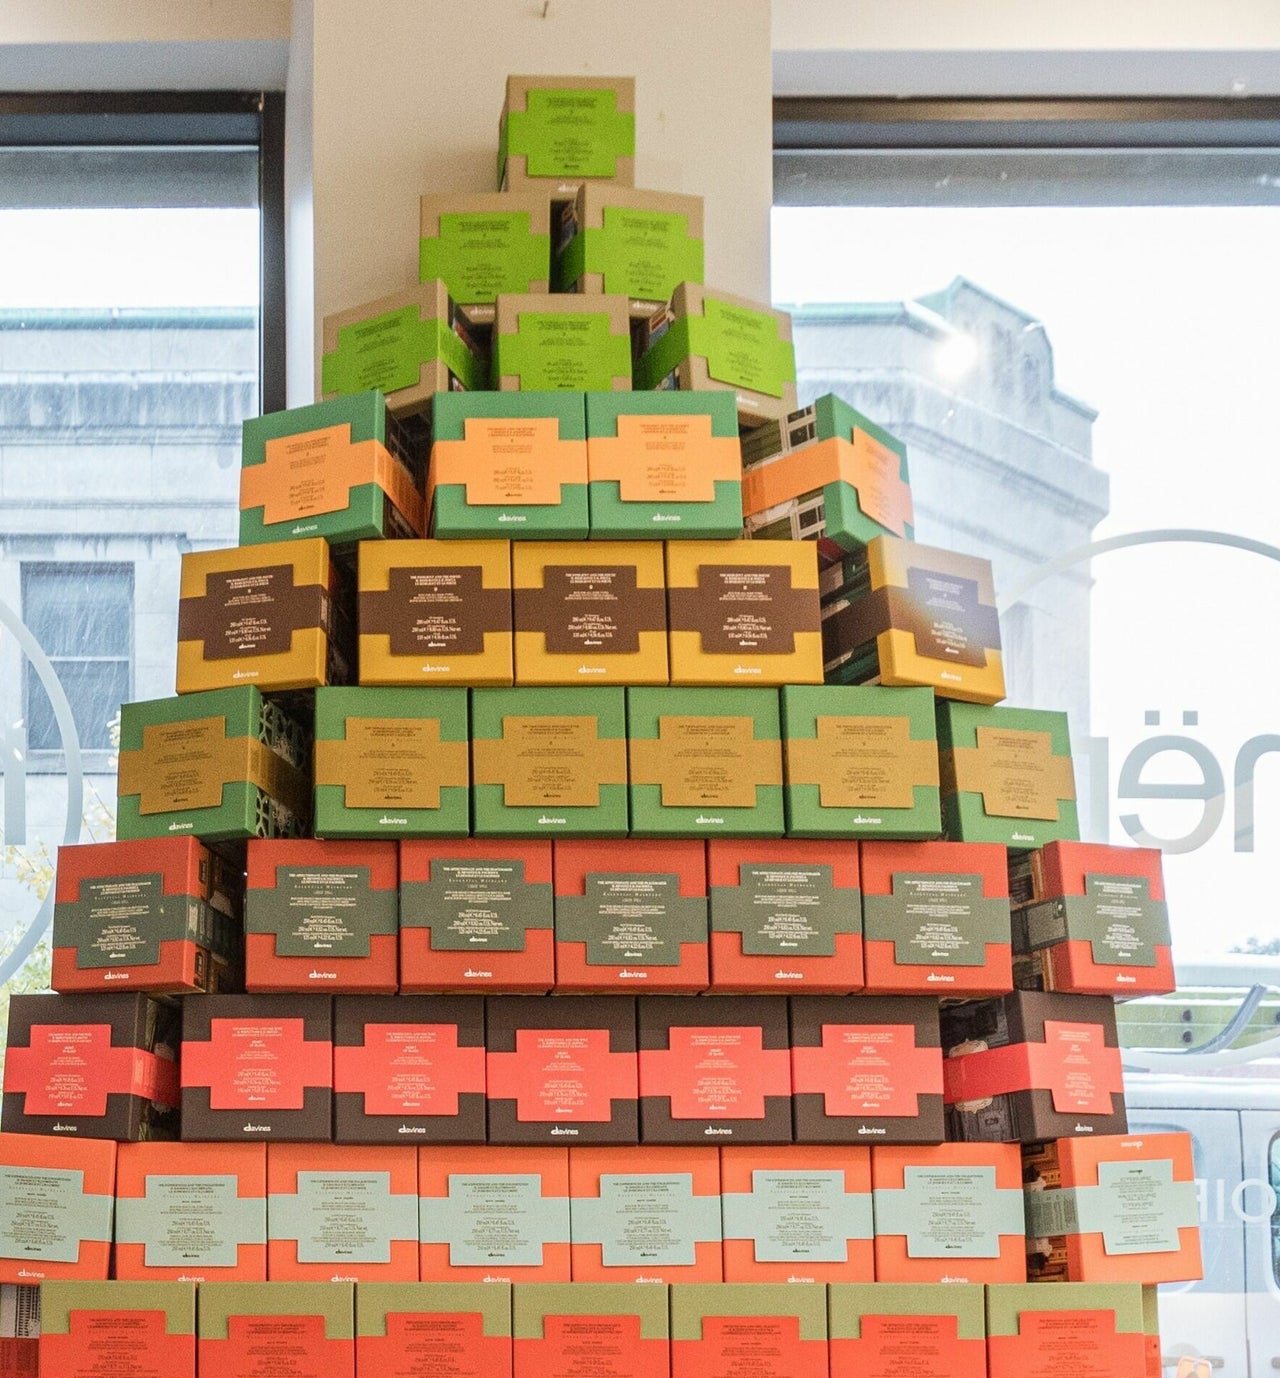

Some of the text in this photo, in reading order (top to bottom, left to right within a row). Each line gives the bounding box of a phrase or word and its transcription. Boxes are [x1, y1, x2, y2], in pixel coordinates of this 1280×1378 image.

[498, 514, 526, 522] davines
[292, 525, 317, 534] davines
[422, 664, 449, 672] davines
[578, 666, 606, 674] davines
[734, 666, 761, 674] davines
[233, 670, 258, 679] davines
[379, 816, 407, 824] davines
[538, 816, 566, 824] davines
[696, 815, 724, 823] davines
[854, 815, 881, 824] davines
[169, 822, 193, 830] davines
[104, 972, 129, 980] davines
[309, 970, 336, 978] davines
[464, 969, 492, 977] davines
[619, 970, 647, 978] davines
[775, 970, 803, 978] davines
[927, 973, 954, 981] davines
[53, 1123, 77, 1131] davines
[243, 1123, 271, 1131] davines
[398, 1125, 426, 1133] davines
[551, 1127, 578, 1135] davines
[705, 1126, 732, 1135] davines
[858, 1126, 886, 1134] davines
[18, 1269, 45, 1278] davines
